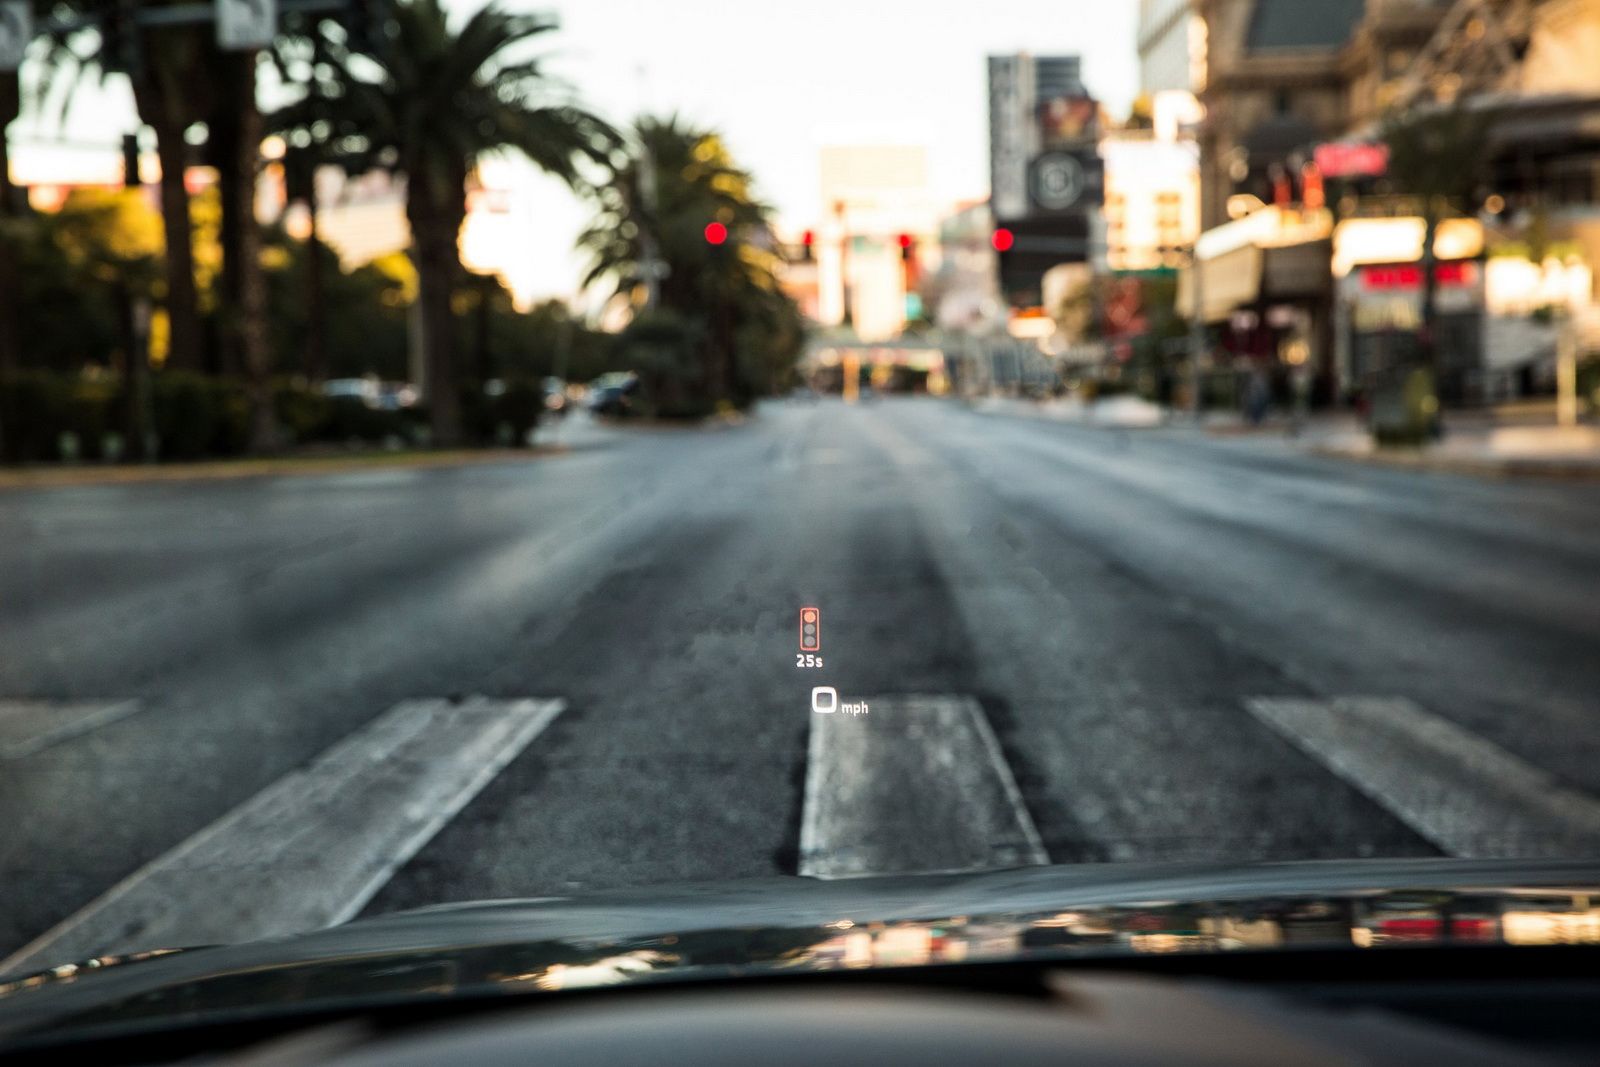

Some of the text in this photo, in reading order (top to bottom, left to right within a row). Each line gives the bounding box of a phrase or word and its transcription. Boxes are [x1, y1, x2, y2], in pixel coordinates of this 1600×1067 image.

[796, 654, 823, 668] 25s
[812, 687, 869, 717] 0 mph
